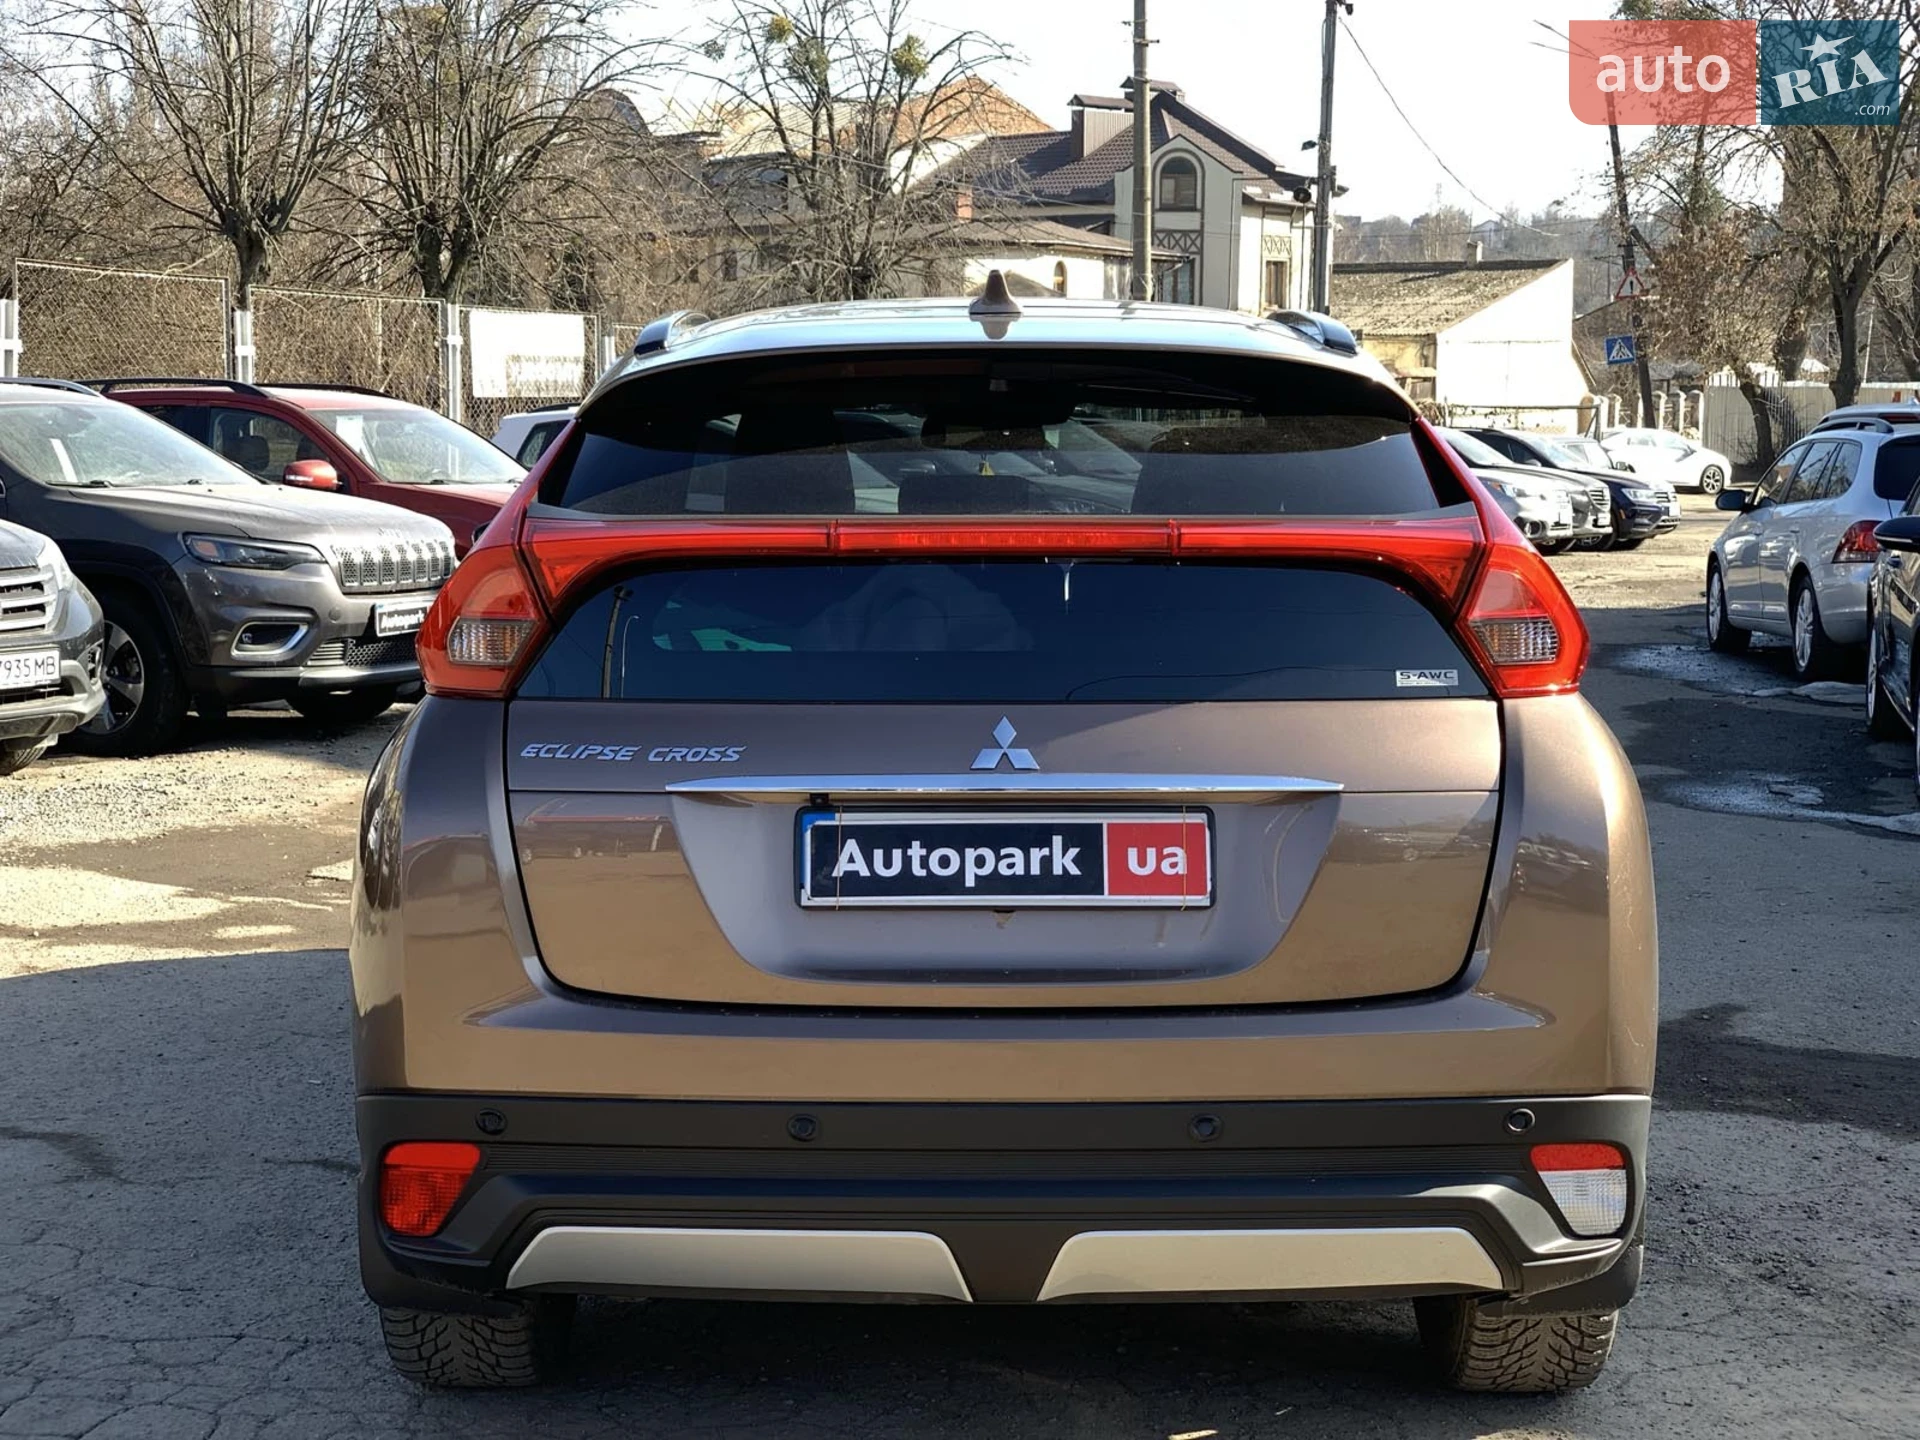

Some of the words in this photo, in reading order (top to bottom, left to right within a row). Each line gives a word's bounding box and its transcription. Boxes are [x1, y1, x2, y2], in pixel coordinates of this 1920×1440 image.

[34, 656, 56, 676] MB
[1400, 671, 1455, 680] S-AWC
[520, 743, 643, 762] ECLIPSE
[648, 745, 748, 762] CROSS
[831, 834, 1082, 888] Autopark
[1127, 845, 1188, 876] ua
